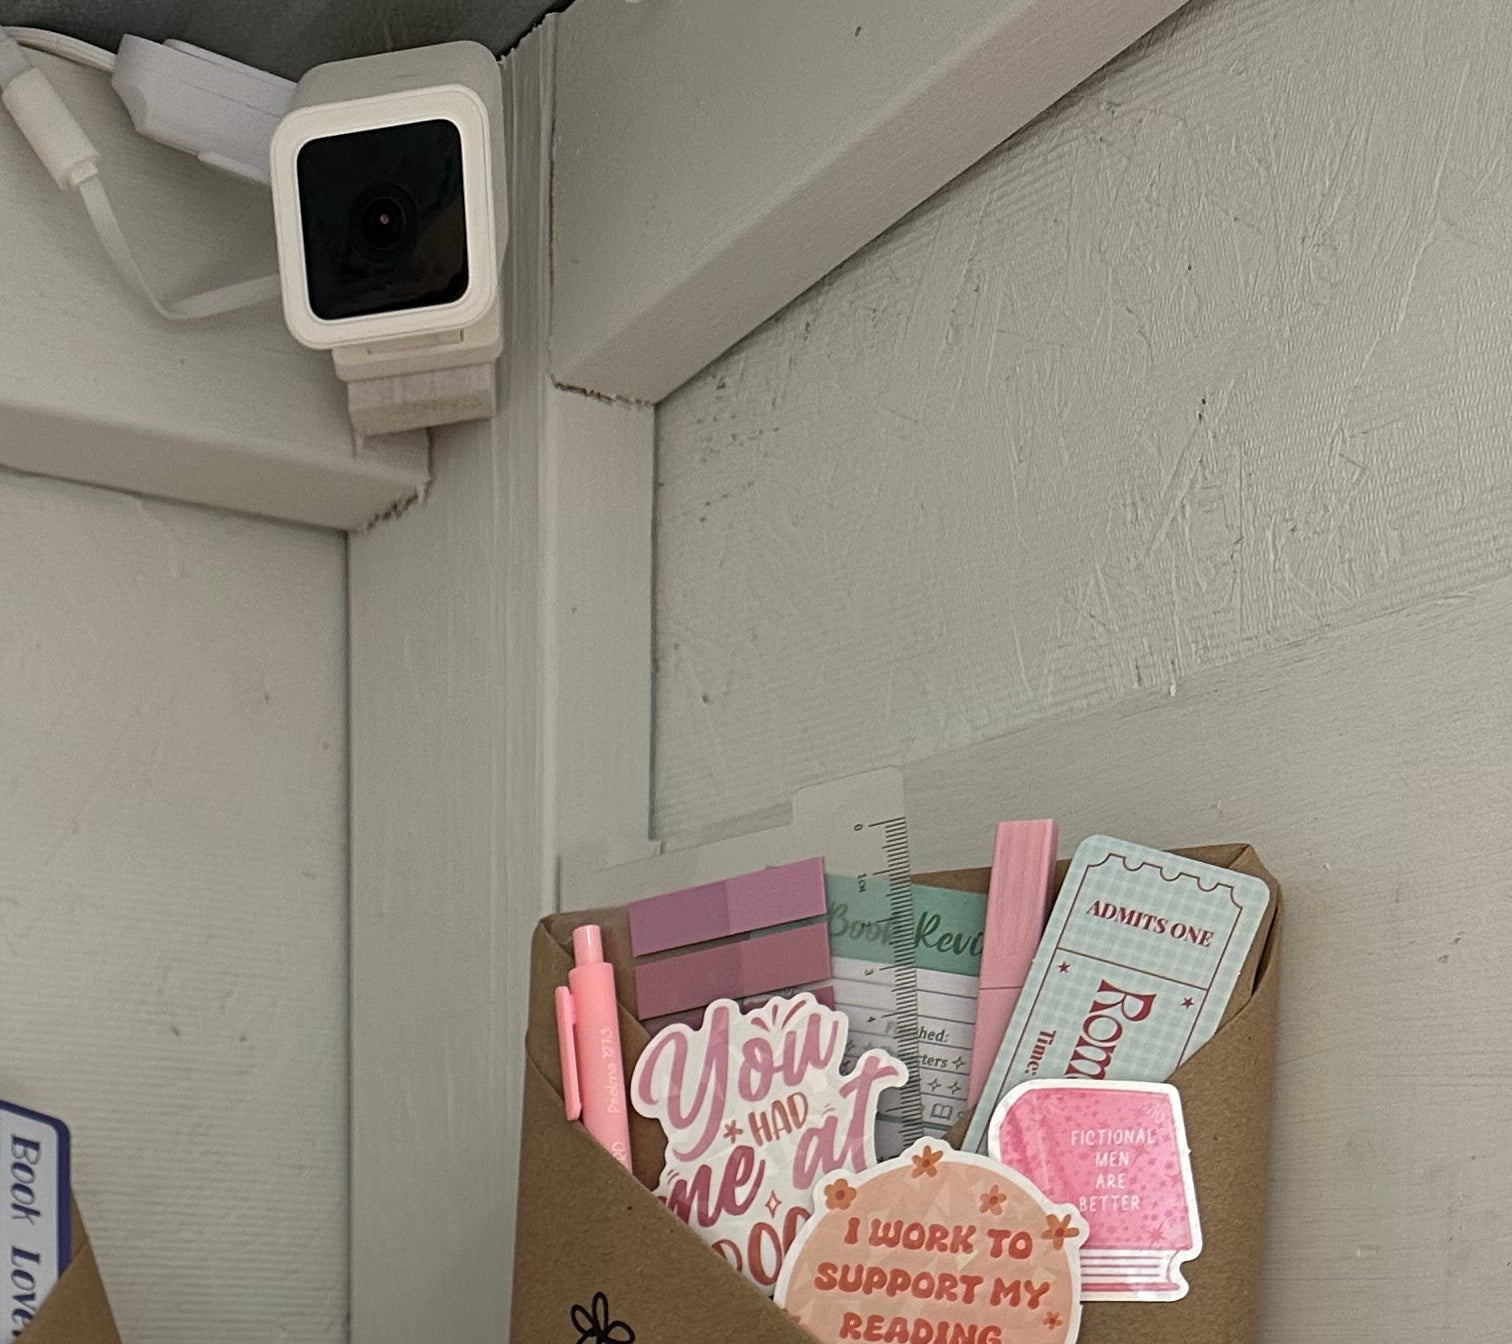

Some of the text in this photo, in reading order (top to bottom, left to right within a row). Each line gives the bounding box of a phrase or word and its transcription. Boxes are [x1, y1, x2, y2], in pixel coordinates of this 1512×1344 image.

[1087, 900, 1214, 948] ADMITS ONE
[638, 1005, 839, 1162] You
[748, 1091, 808, 1146] HAD
[792, 1056, 900, 1190] at
[1070, 1129, 1157, 1146] FICTIONAL
[10, 1134, 42, 1225] Book
[1095, 1150, 1129, 1167] MEN
[1095, 1173, 1126, 1189] ARE
[1079, 1194, 1140, 1213] BETTER
[844, 1217, 1033, 1259] I WORK TO
[814, 1262, 1050, 1310] SUPPORT MY
